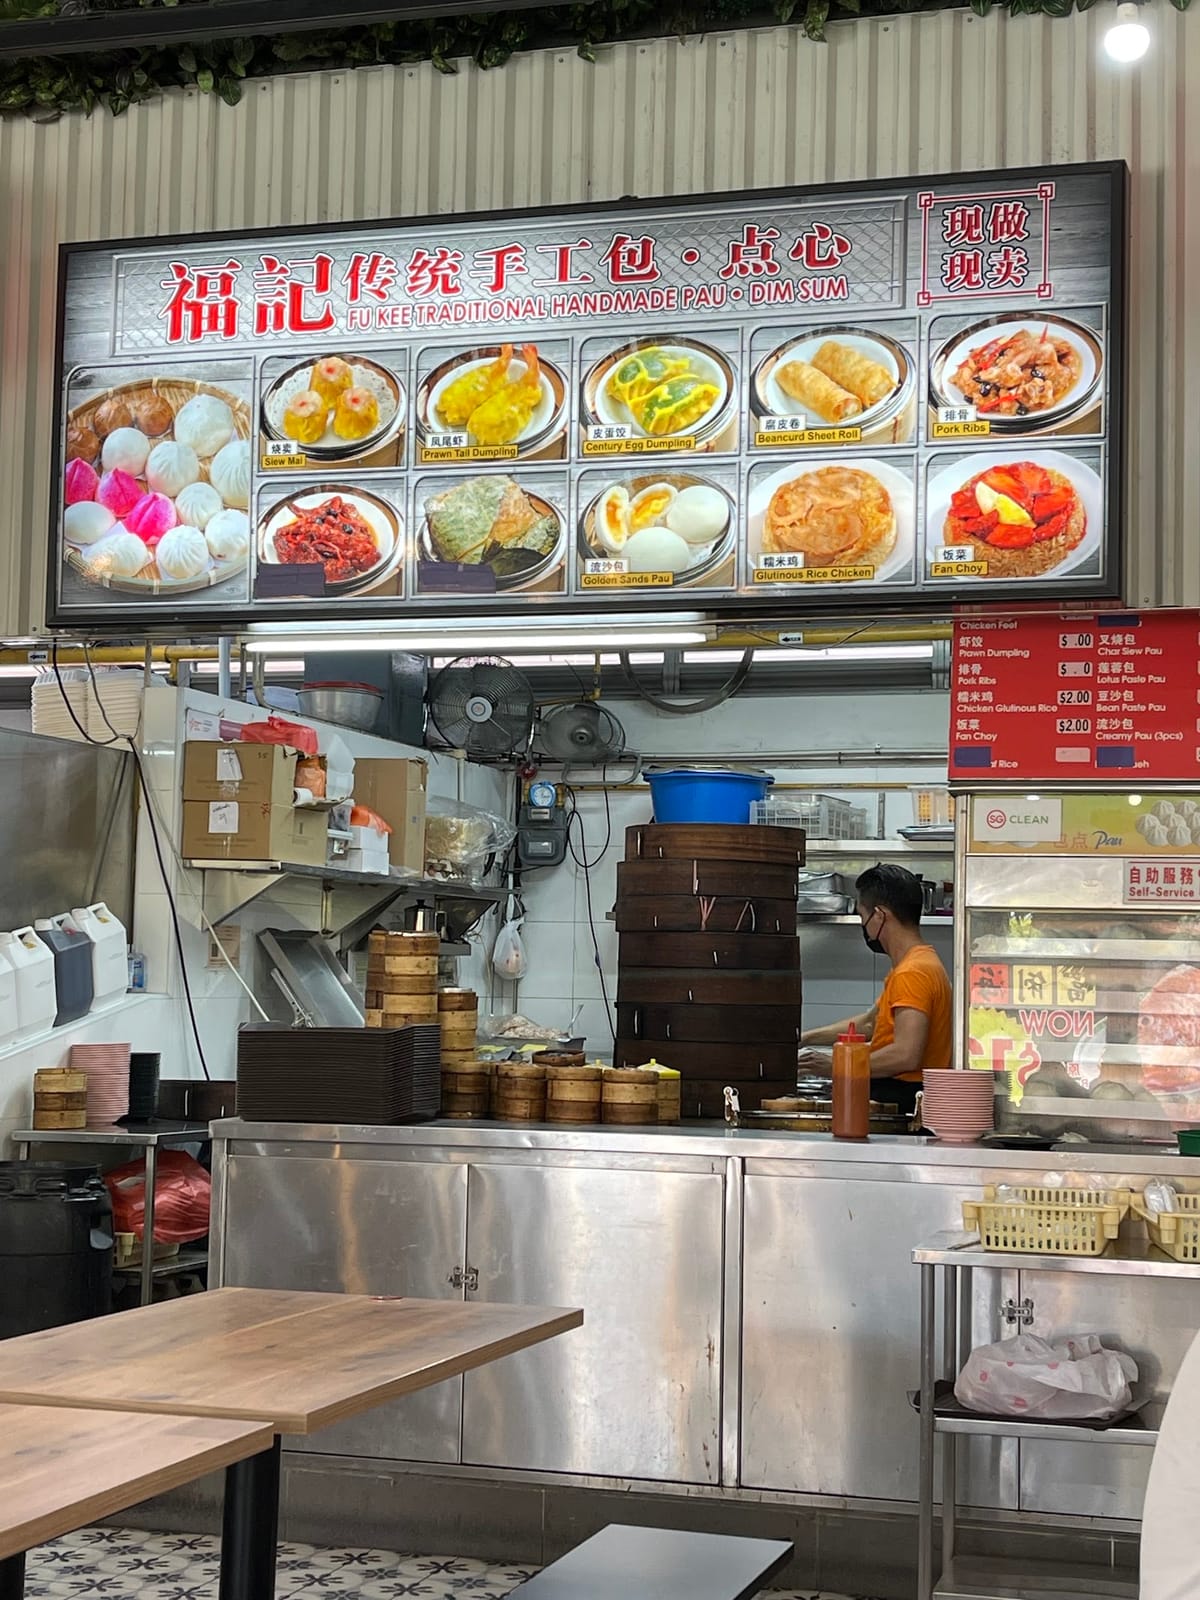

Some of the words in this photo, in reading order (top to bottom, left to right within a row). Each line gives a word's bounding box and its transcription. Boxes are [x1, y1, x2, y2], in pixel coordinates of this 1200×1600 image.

[943, 203, 1030, 246] 现做
[942, 248, 1029, 291] 现卖
[348, 307, 370, 329] FU
[377, 305, 411, 328] KEE
[416, 297, 547, 325] TRADITIONAL
[551, 287, 678, 317] HANDMADE
[682, 284, 726, 310] PAU
[750, 279, 794, 305] DIM
[798, 276, 848, 301] SUM
[936, 424, 960, 434] Pork
[963, 423, 986, 433] Ribs
[757, 431, 806, 443] Beancurd
[807, 430, 836, 441] Sheet
[838, 429, 858, 440] Roll
[585, 441, 623, 453] Century
[625, 439, 644, 451] Egg
[646, 437, 692, 450] Dumpling
[424, 449, 452, 460] Prawn
[454, 449, 471, 459] Tail
[472, 446, 517, 460] Dumpling
[264, 457, 286, 467] Siew
[288, 456, 303, 465] Mai
[755, 569, 804, 580] Glutinous
[806, 568, 828, 579] Rice
[830, 567, 871, 578] Chicken
[934, 564, 953, 574] Fan
[955, 563, 983, 575] Choy
[583, 574, 618, 586] Golden
[620, 574, 650, 585] Sands
[651, 573, 670, 583] Pau
[960, 621, 996, 630] Chicken
[959, 649, 986, 657] Prawn
[987, 648, 1030, 659] Dumpling
[1097, 647, 1120, 656] Char
[1121, 646, 1144, 656] Siew
[1145, 646, 1163, 655] Pau
[958, 676, 977, 685] Pork
[979, 676, 997, 685] Ribs
[1097, 675, 1120, 684] Lotus
[1121, 674, 1146, 684] Paste
[1148, 674, 1166, 683] Pau
[1059, 690, 1090, 704] $2.00
[956, 703, 994, 713] Chicken
[995, 703, 1037, 713] Glutinous
[1037, 703, 1058, 712] Rice
[1096, 703, 1120, 712] Bean
[1121, 703, 1146, 712] Paste
[1148, 703, 1167, 712] Pau
[1058, 719, 1089, 733] $2.00
[955, 732, 972, 741] Fan
[973, 732, 998, 742] Choy
[1095, 731, 1132, 742] Creamy
[1134, 731, 1152, 741] Pau
[1154, 731, 1184, 742] (3pcs)
[998, 759, 1019, 768] Rice
[988, 814, 1005, 825] SG
[1008, 814, 1050, 825] CLEAN
[1092, 830, 1123, 850] Pau
[1128, 886, 1195, 898] Self-Service
